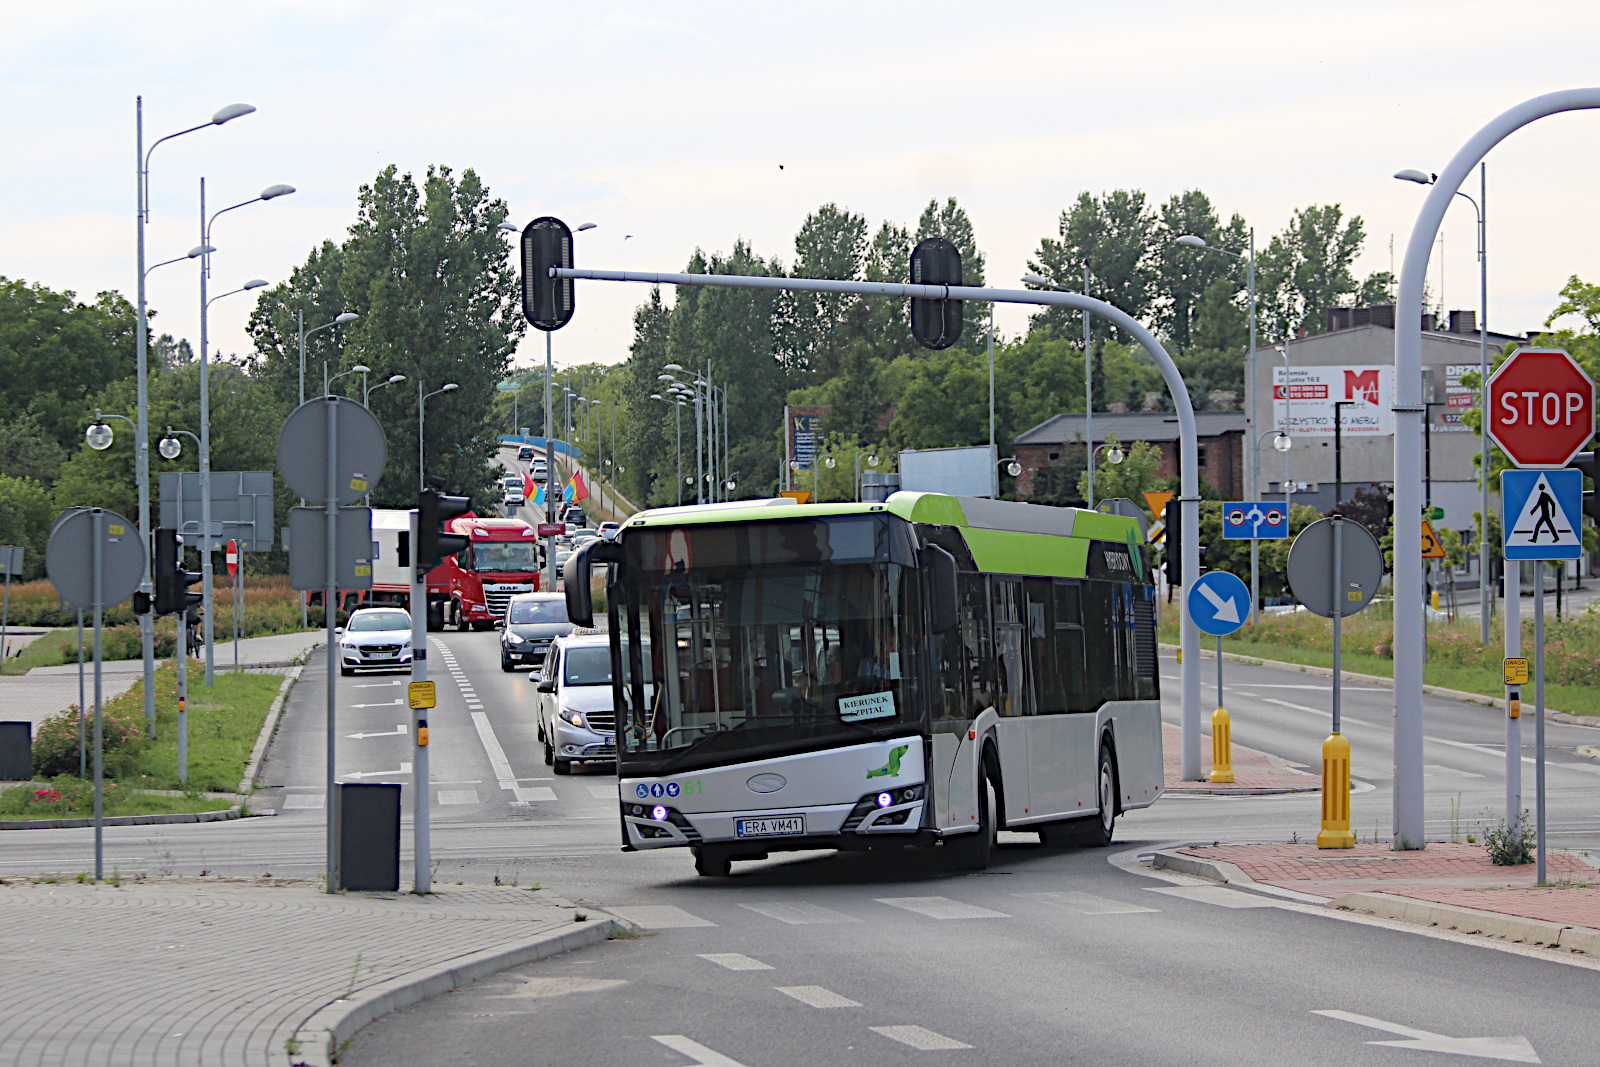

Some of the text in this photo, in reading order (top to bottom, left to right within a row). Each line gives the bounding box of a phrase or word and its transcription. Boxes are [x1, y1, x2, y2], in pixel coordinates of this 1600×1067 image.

[1501, 391, 1584, 426] STOP
[794, 417, 806, 430] K
[844, 695, 889, 709] KIERUNEK
[684, 779, 703, 796] 61
[745, 819, 799, 833] ERA VM41
